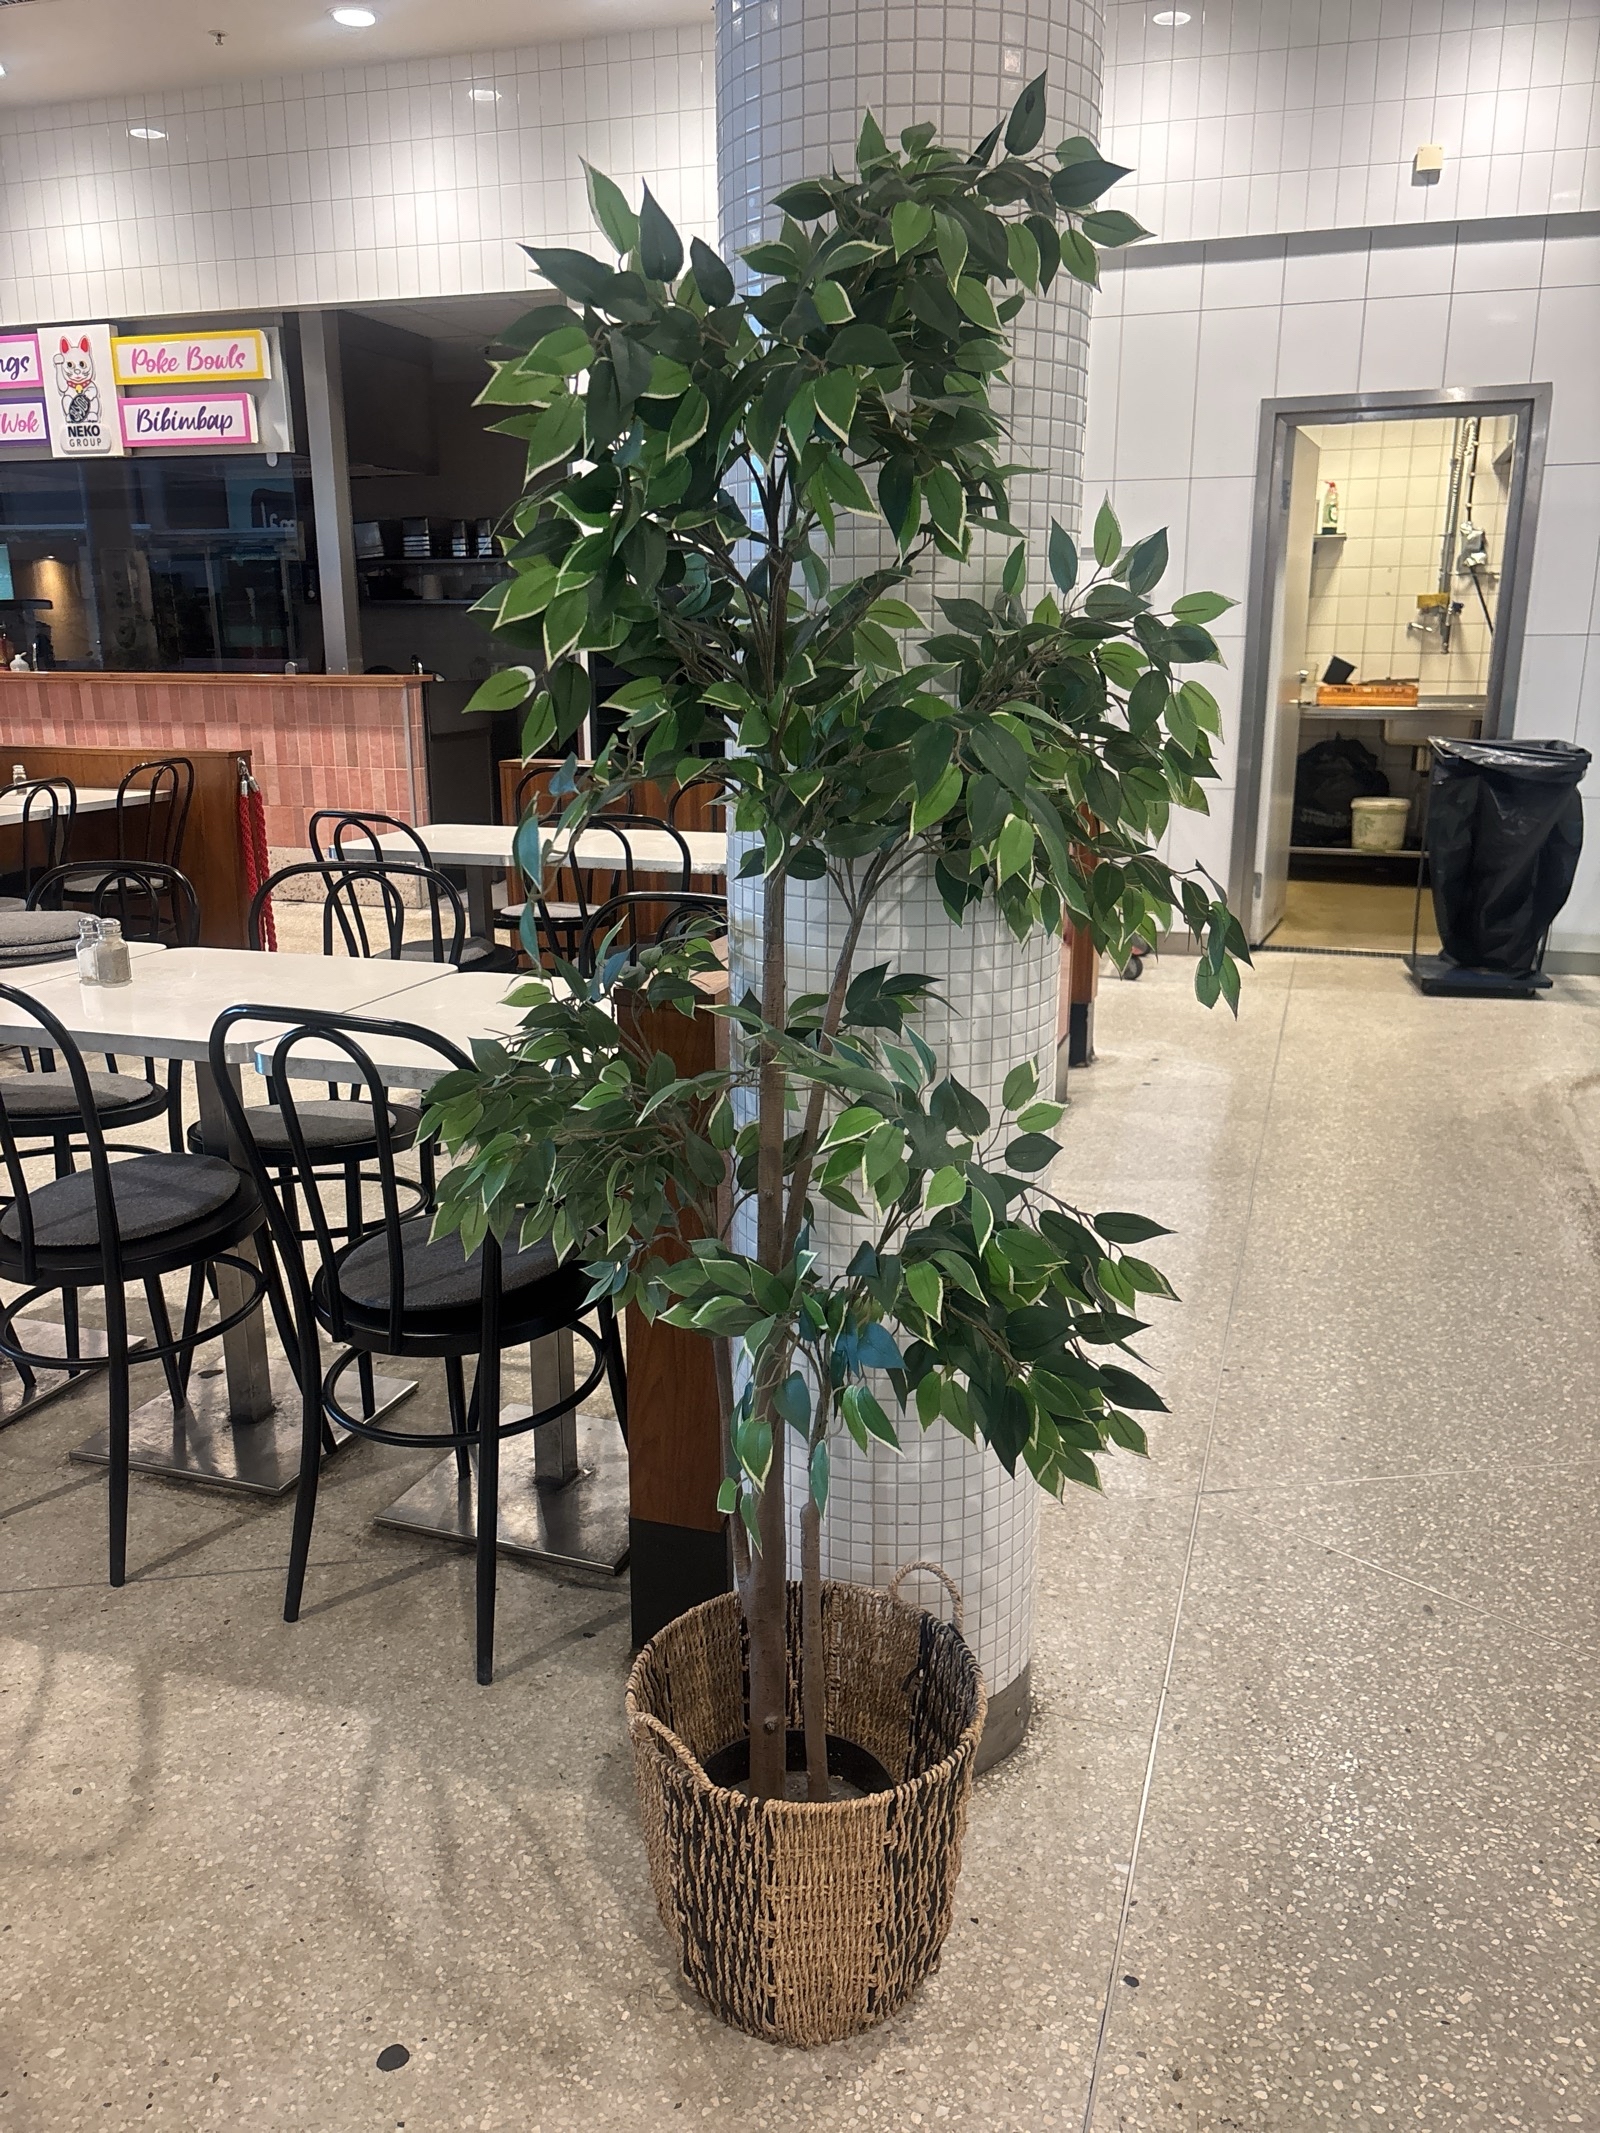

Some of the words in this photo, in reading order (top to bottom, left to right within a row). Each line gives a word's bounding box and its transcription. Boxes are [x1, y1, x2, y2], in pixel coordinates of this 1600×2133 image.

[131, 348, 180, 374] Poke
[187, 343, 246, 371] Bowls
[1, 410, 40, 434] Wok
[67, 425, 101, 437] NEKO
[136, 405, 233, 436] Bibimbap
[69, 437, 102, 448] GROUP
